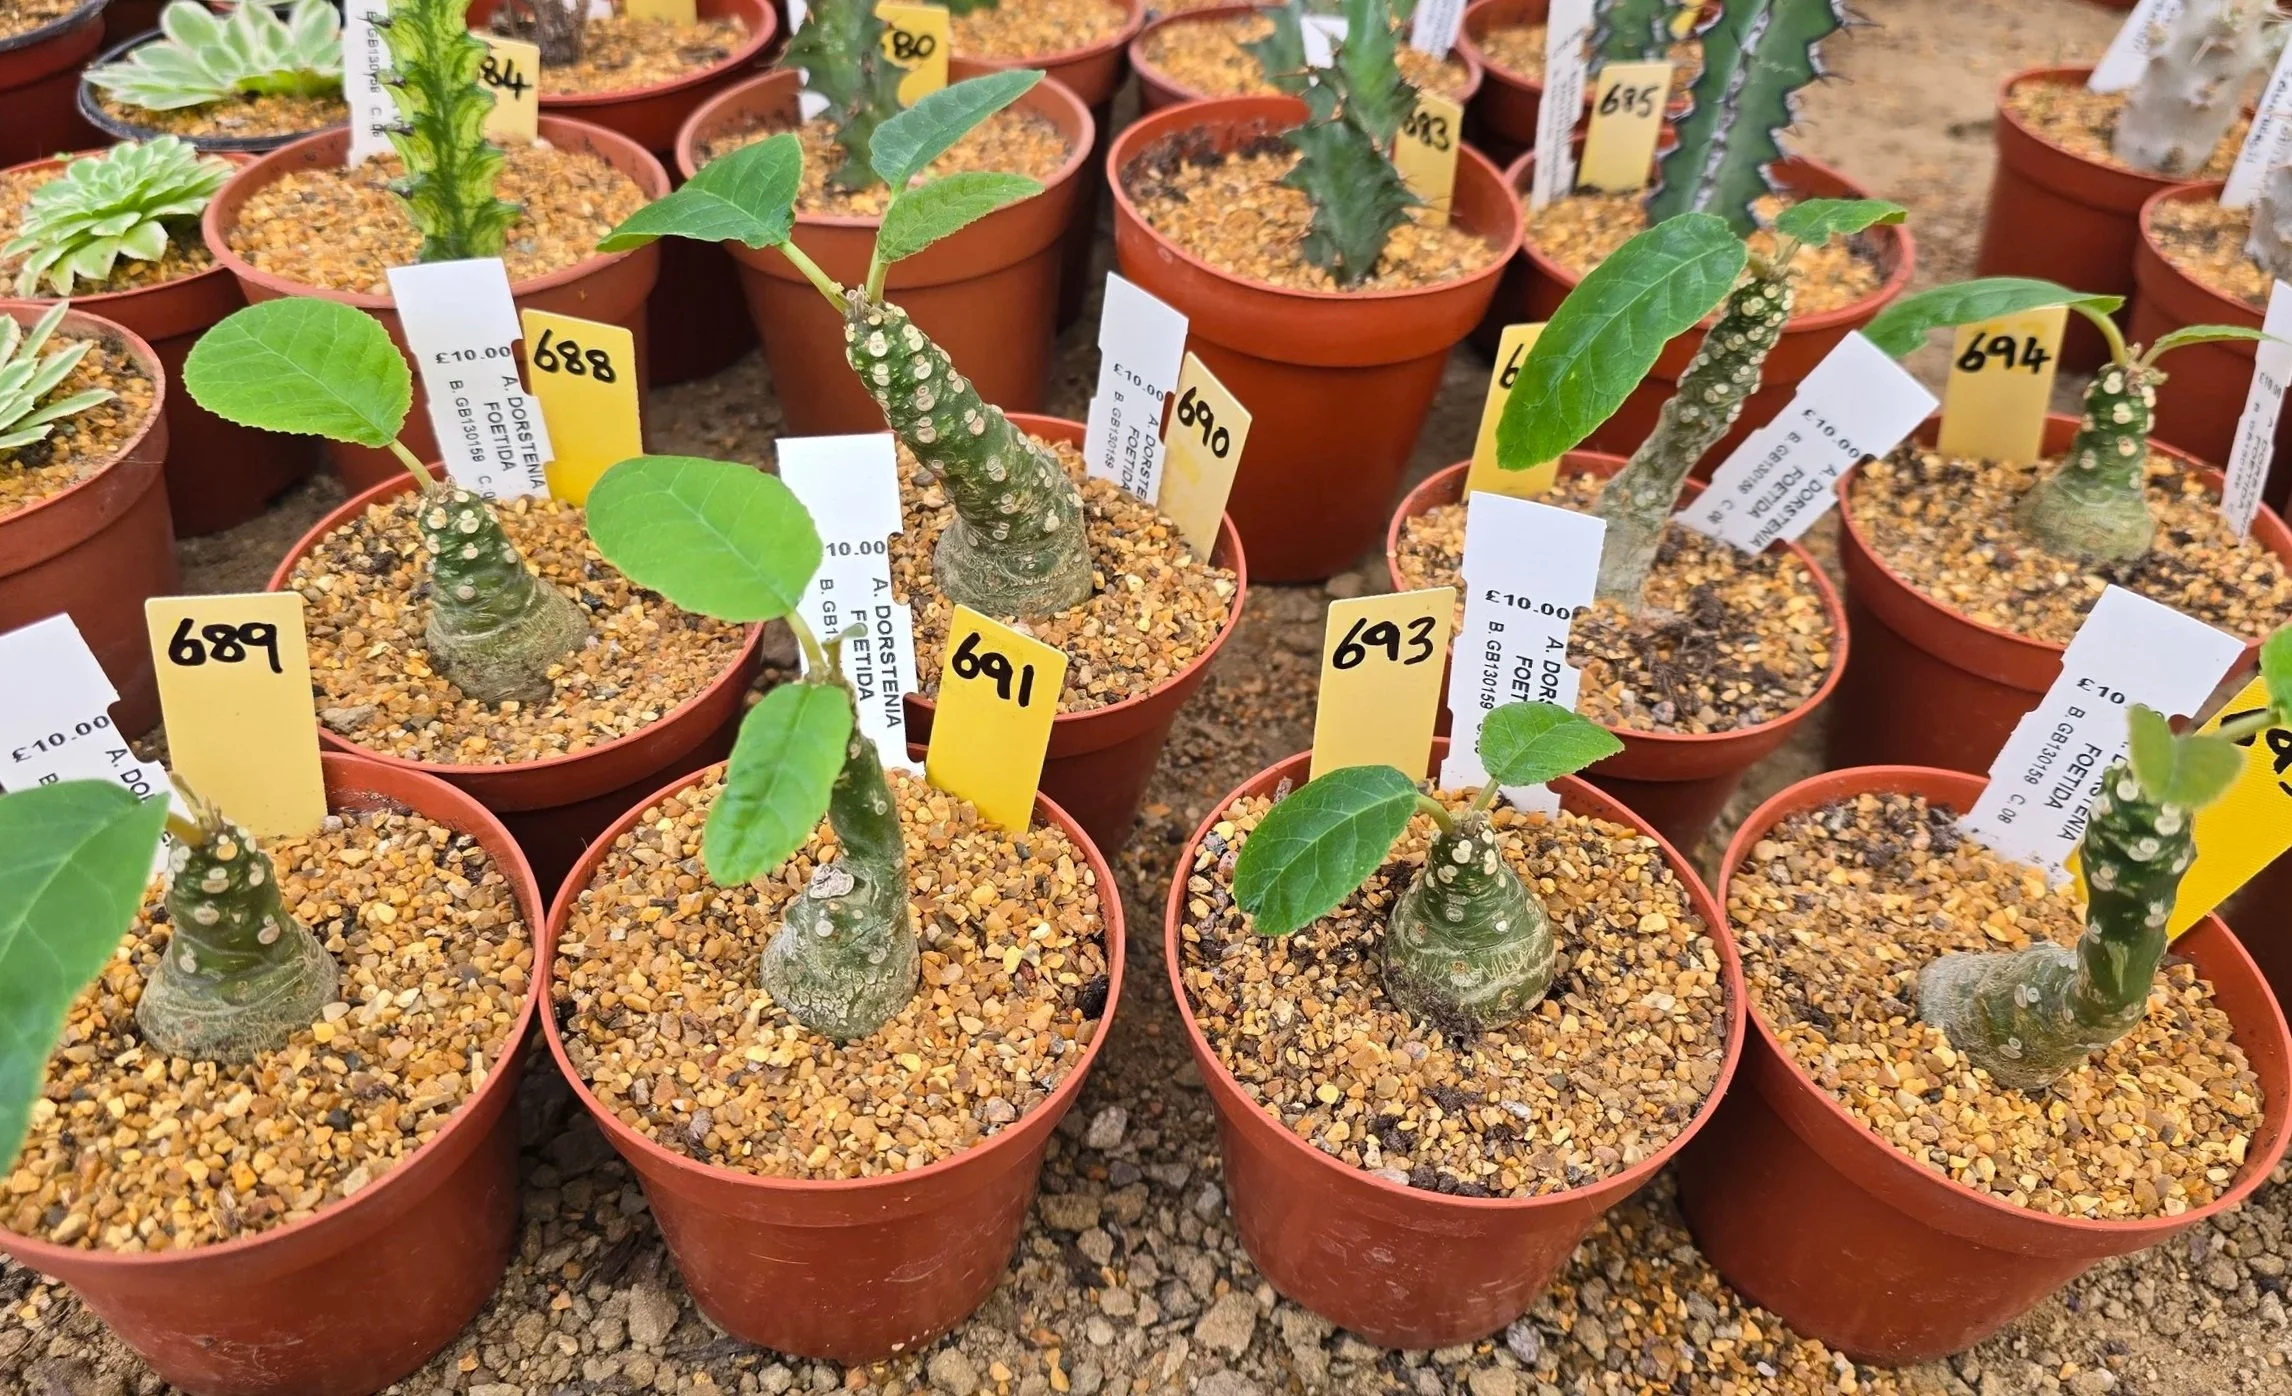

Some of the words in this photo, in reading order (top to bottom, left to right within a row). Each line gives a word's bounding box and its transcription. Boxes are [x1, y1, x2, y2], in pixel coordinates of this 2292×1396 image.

[882, 31, 937, 60] 80
[480, 55, 533, 100] 84
[435, 346, 511, 364] £10.00
[534, 329, 616, 384] 688
[1499, 343, 1525, 390] 6
[1955, 332, 2051, 375] 694
[449, 380, 464, 394] B.
[501, 375, 518, 392] A.
[1113, 363, 1164, 402] £10.00
[484, 401, 517, 472] FOETIDA
[508, 396, 546, 490] DORSTENIA
[1177, 386, 1230, 459] 690
[1801, 408, 1861, 459] £10.00
[1120, 424, 1141, 492] FOETIDA
[1135, 433, 1156, 503] DORSTE
[1746, 465, 1805, 520] FOETIDA
[1751, 479, 1825, 548] DORSTENIA
[826, 540, 886, 558] 10.00
[819, 578, 835, 596] B.
[872, 577, 889, 598] A.
[1485, 589, 1571, 621] £10.00
[168, 617, 284, 674] 689
[822, 601, 840, 642] GB1
[1332, 616, 1436, 670] 693
[1487, 620, 1505, 635] B.
[1545, 635, 1565, 654] A.
[850, 609, 876, 702] FETIDA
[875, 605, 903, 729] DORSTENIA
[951, 631, 1035, 708] 691
[1479, 638, 1502, 710] GB130159
[1510, 655, 1534, 703] FOET
[1538, 659, 1562, 706] DOR
[2064, 705, 2086, 720] B.
[12, 714, 110, 764] £10.00
[105, 748, 129, 768] A.
[2023, 721, 2075, 786] GB130159
[2043, 742, 2104, 811] FOETIDA
